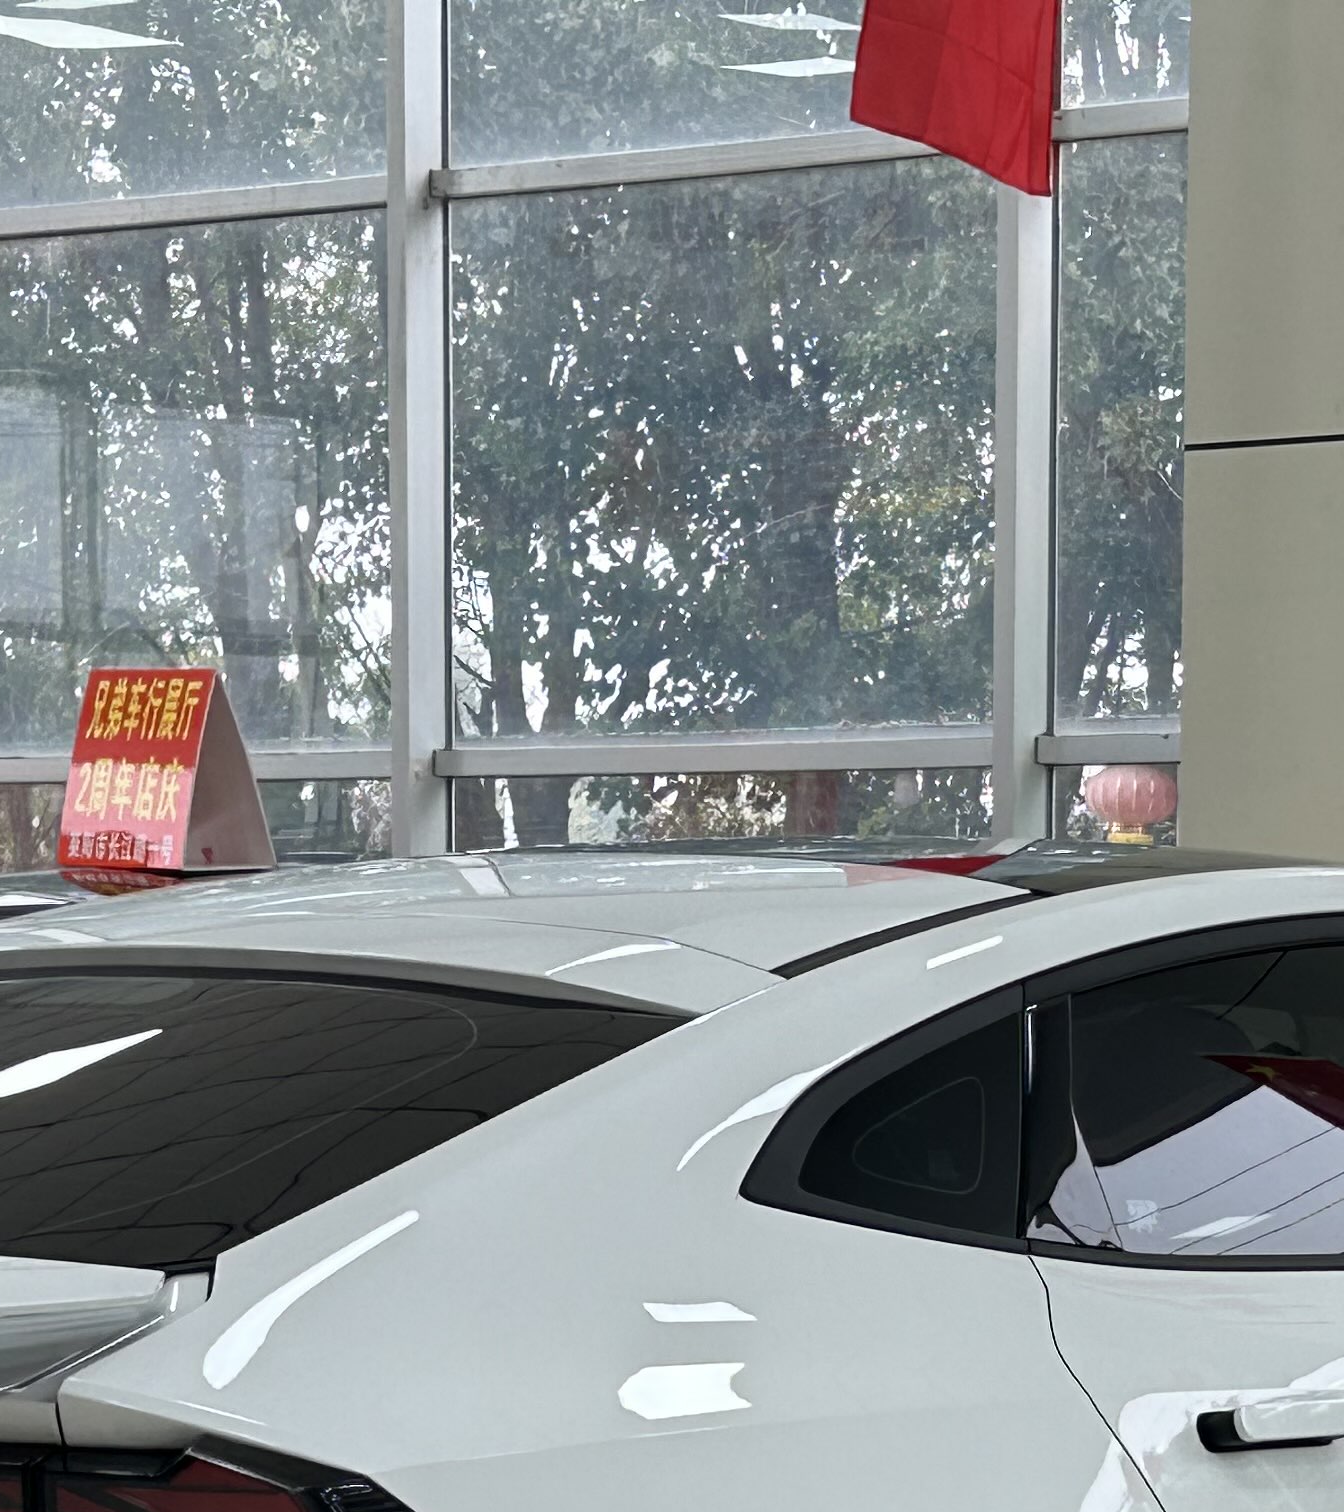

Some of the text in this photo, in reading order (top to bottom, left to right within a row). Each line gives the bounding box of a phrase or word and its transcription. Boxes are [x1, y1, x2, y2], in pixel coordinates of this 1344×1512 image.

[86, 677, 203, 740] 兄弟车行展厅
[74, 757, 184, 821] 2周年店庆
